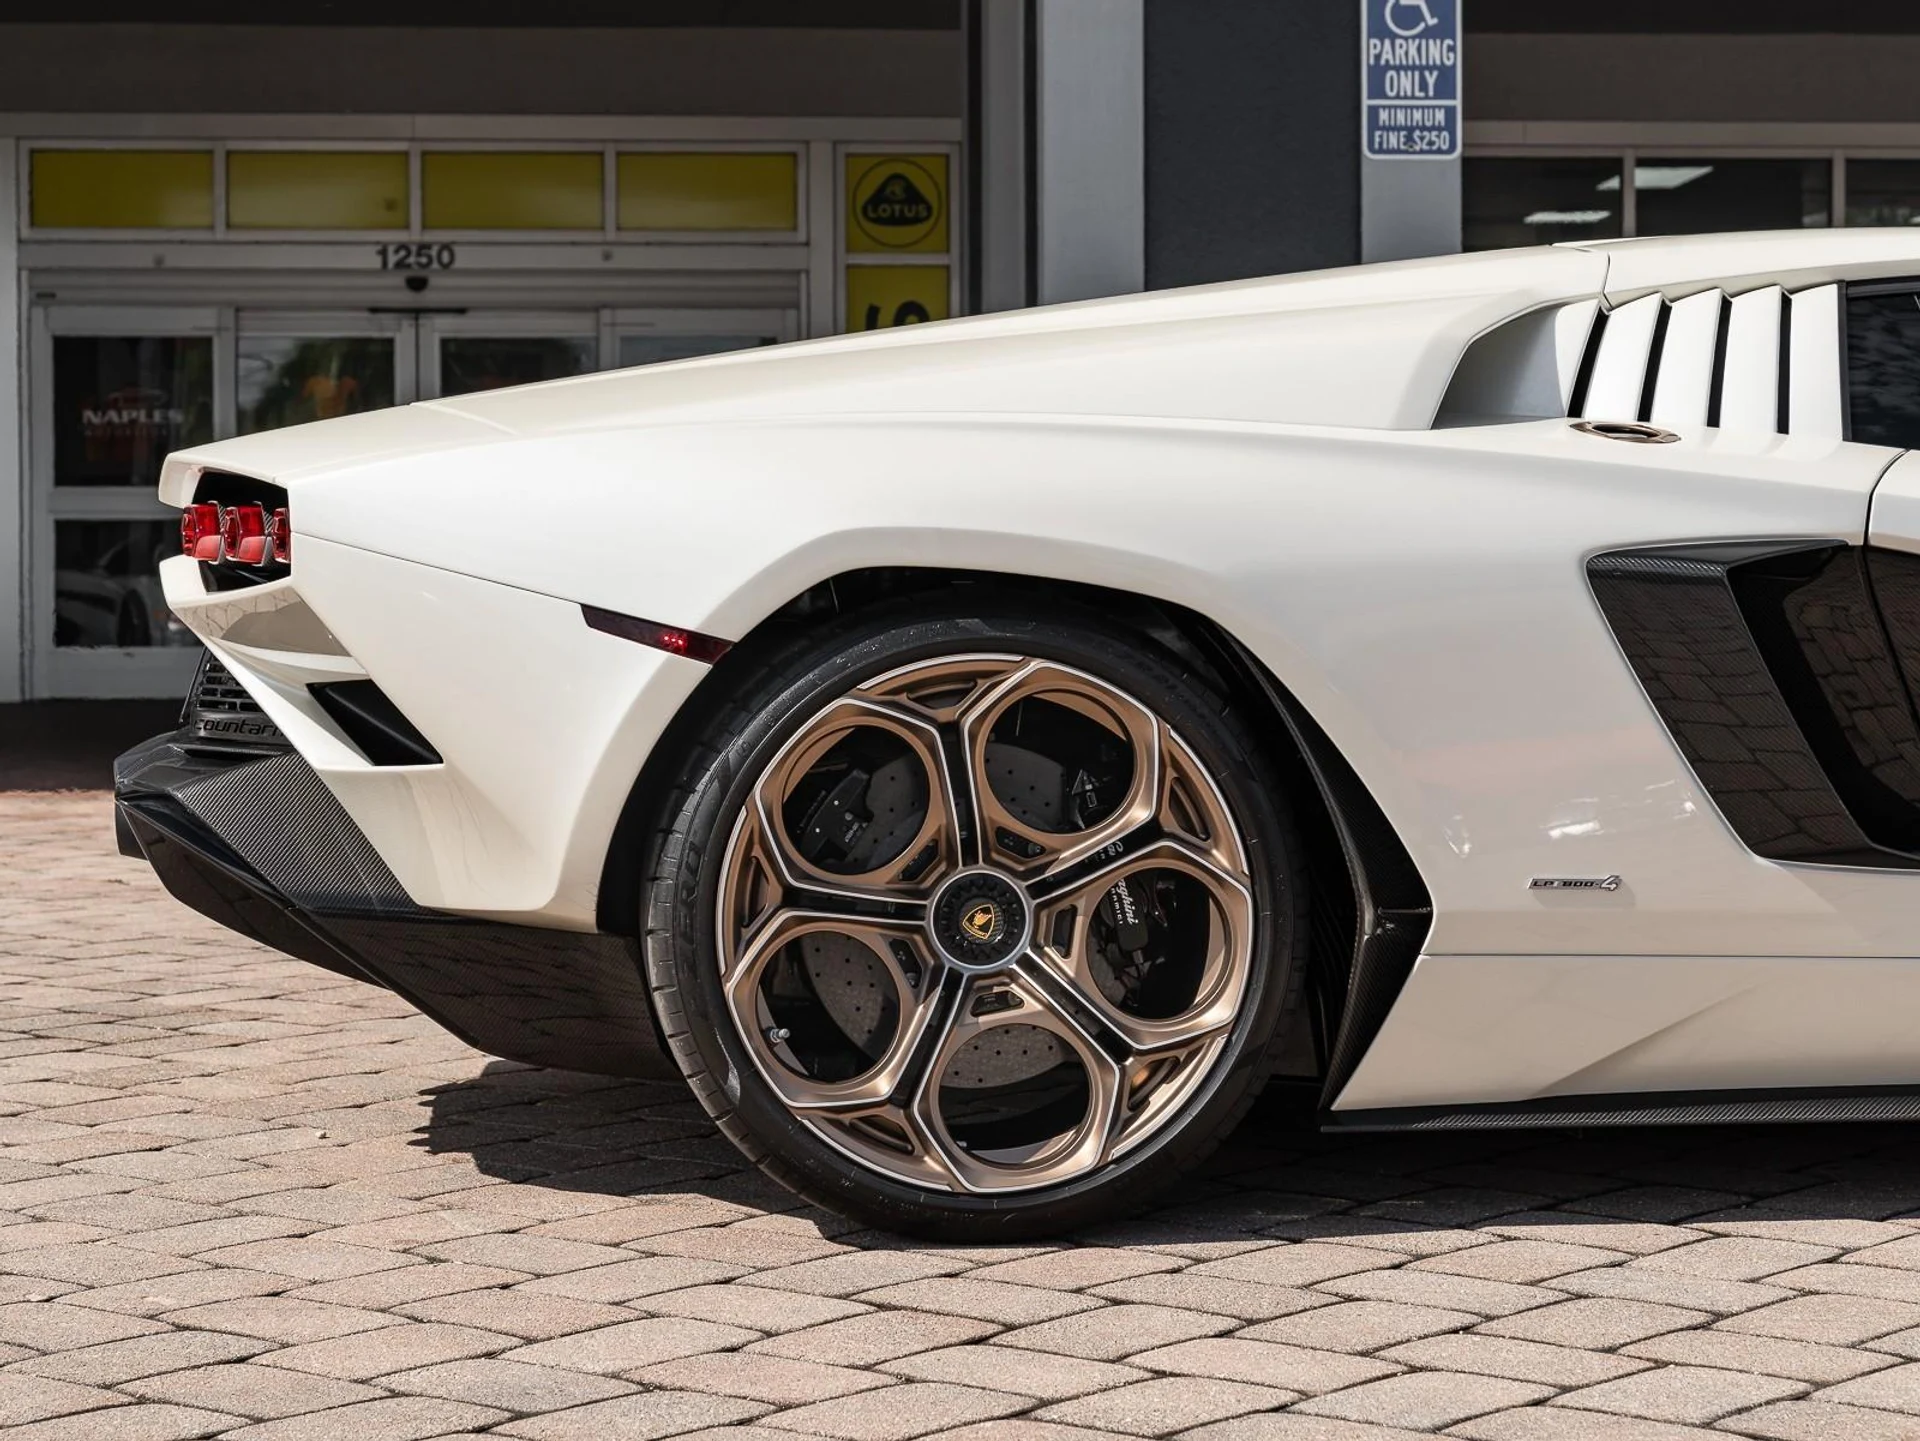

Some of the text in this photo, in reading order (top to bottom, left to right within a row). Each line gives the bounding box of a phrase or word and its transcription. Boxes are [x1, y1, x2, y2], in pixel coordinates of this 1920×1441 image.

[1369, 38, 1455, 66] PARKING
[1385, 70, 1439, 98] ONLY
[1378, 107, 1445, 127] MINIMUM
[1373, 129, 1450, 152] FINE $250
[866, 203, 929, 218] LOTUS
[375, 243, 456, 270] 1250
[82, 409, 185, 424] NAPLES
[1562, 875, 1621, 891] 800-4
